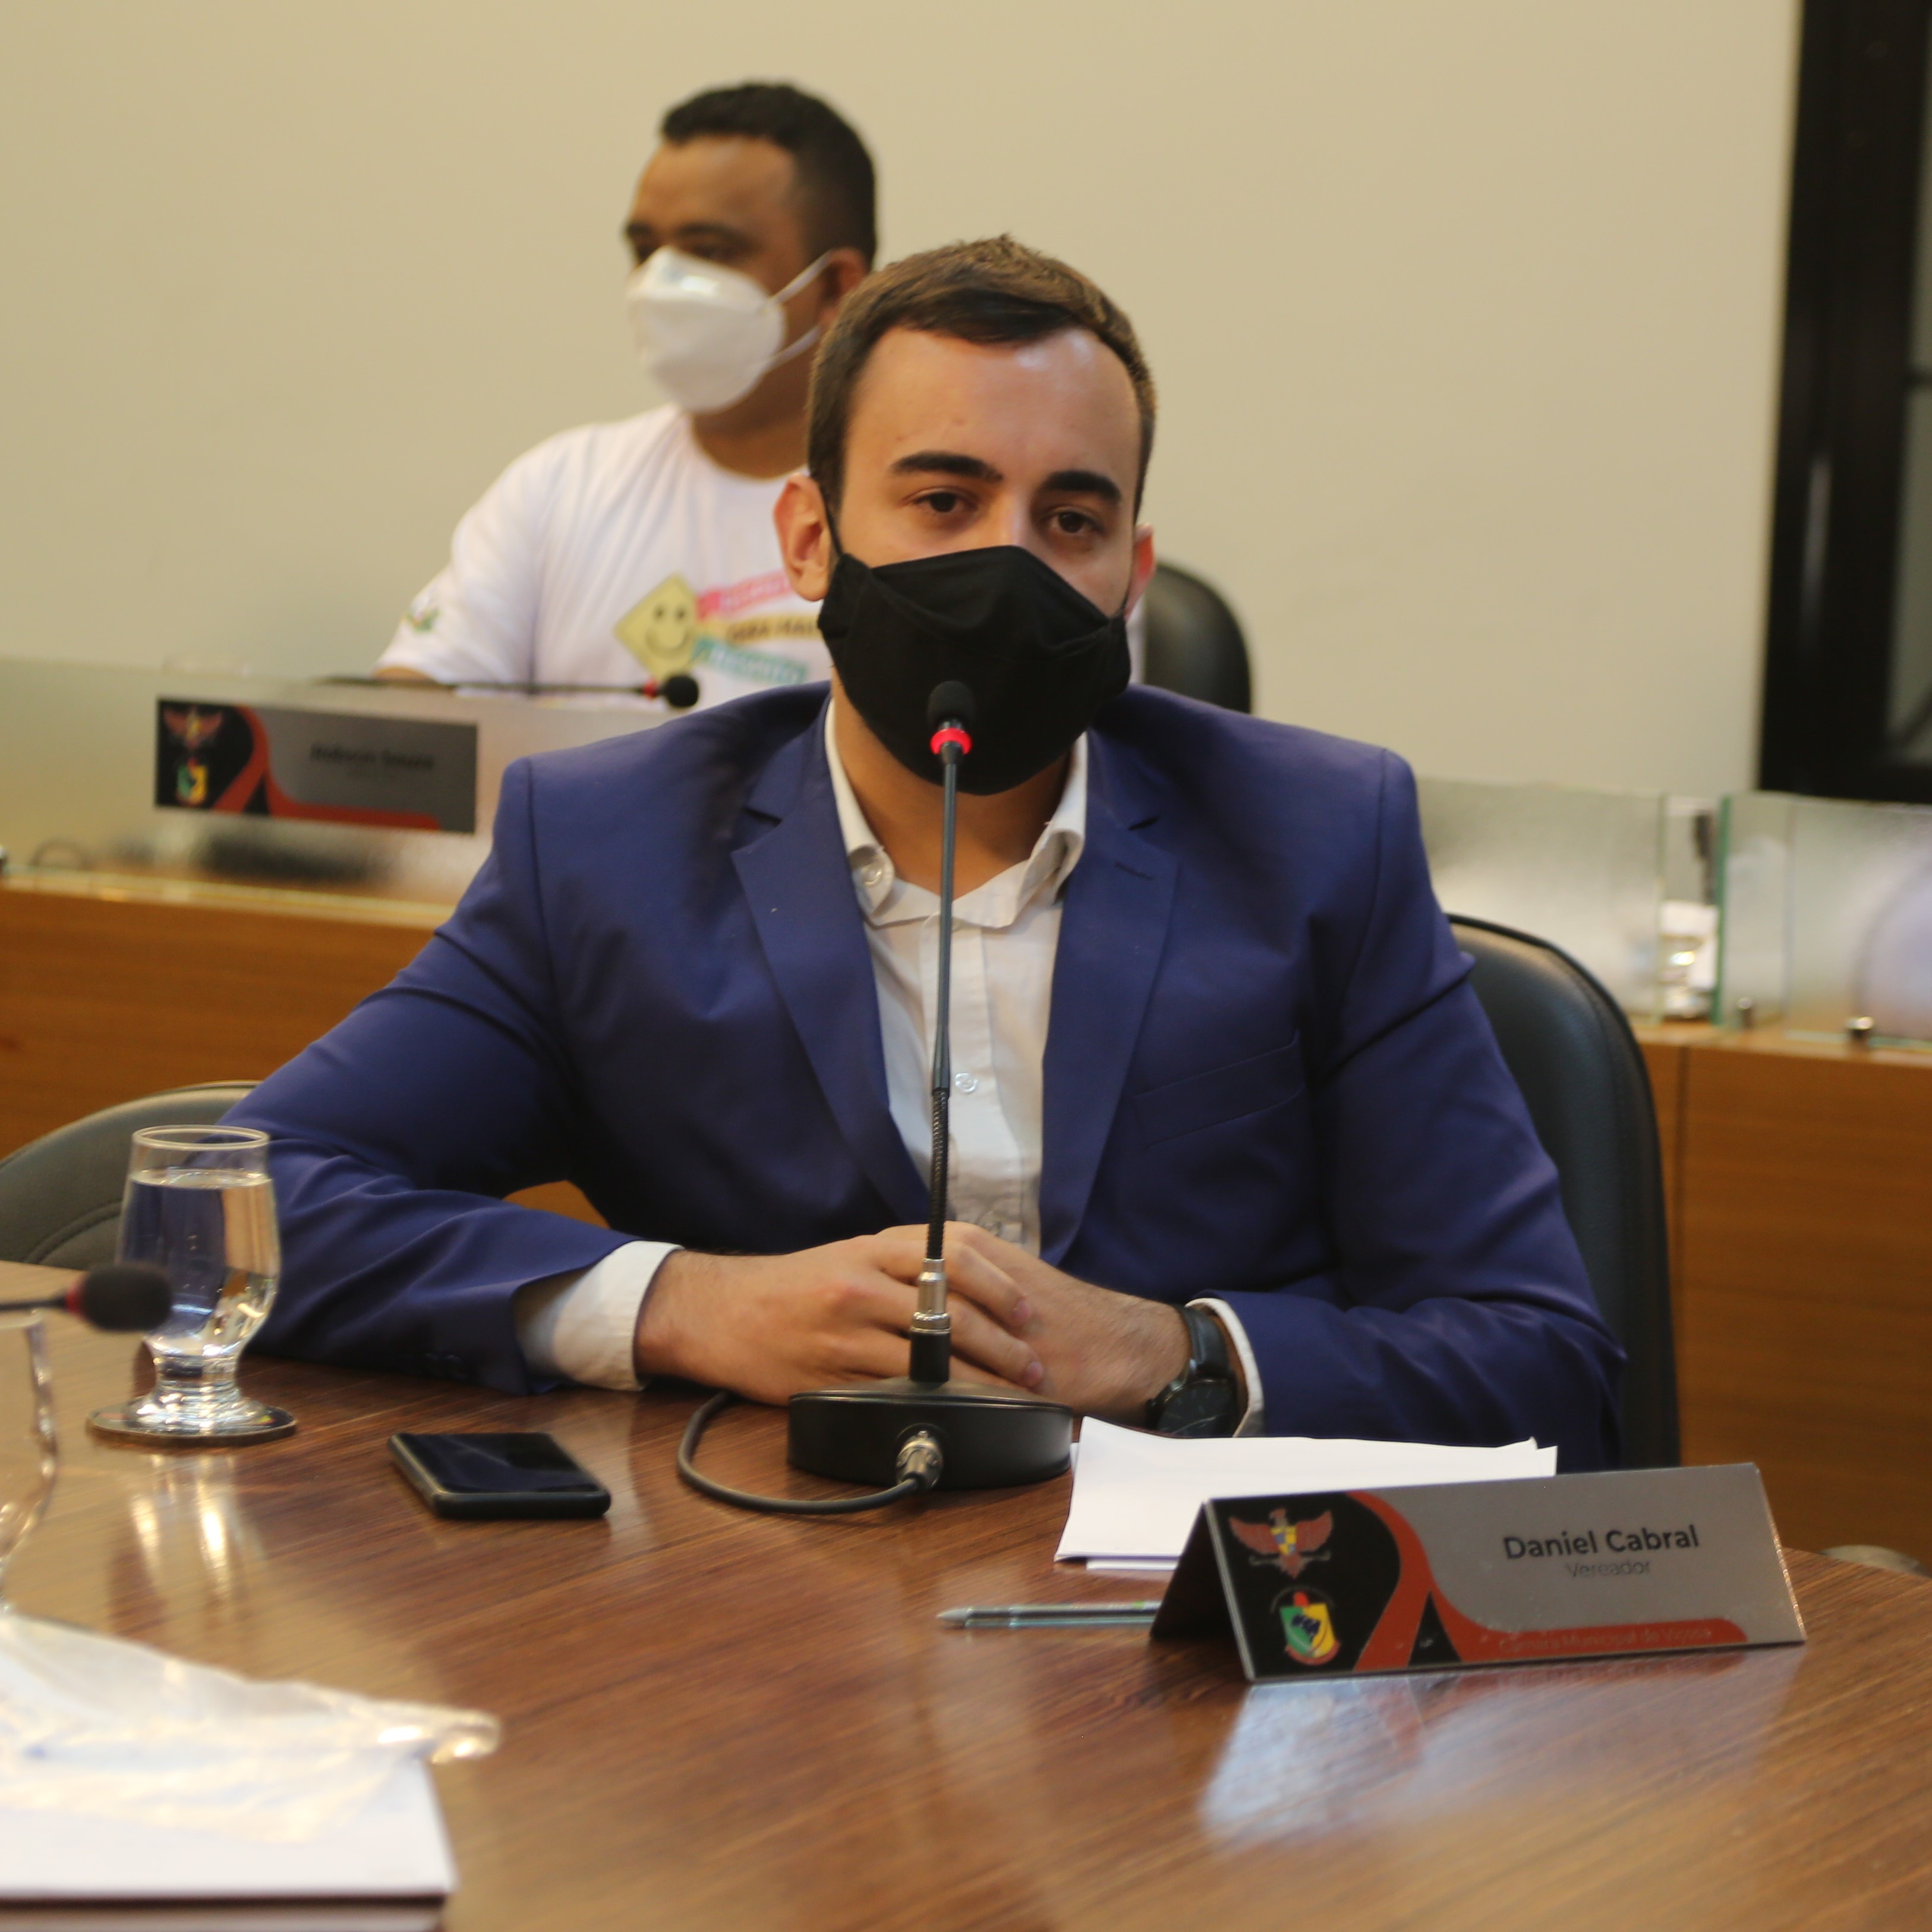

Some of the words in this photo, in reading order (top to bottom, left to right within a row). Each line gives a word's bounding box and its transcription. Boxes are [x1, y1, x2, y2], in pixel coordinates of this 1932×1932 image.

[1503, 1530, 1599, 1559] Daniel
[1605, 1524, 1700, 1553] Cabral
[1565, 1560, 1651, 1578] Vereador
